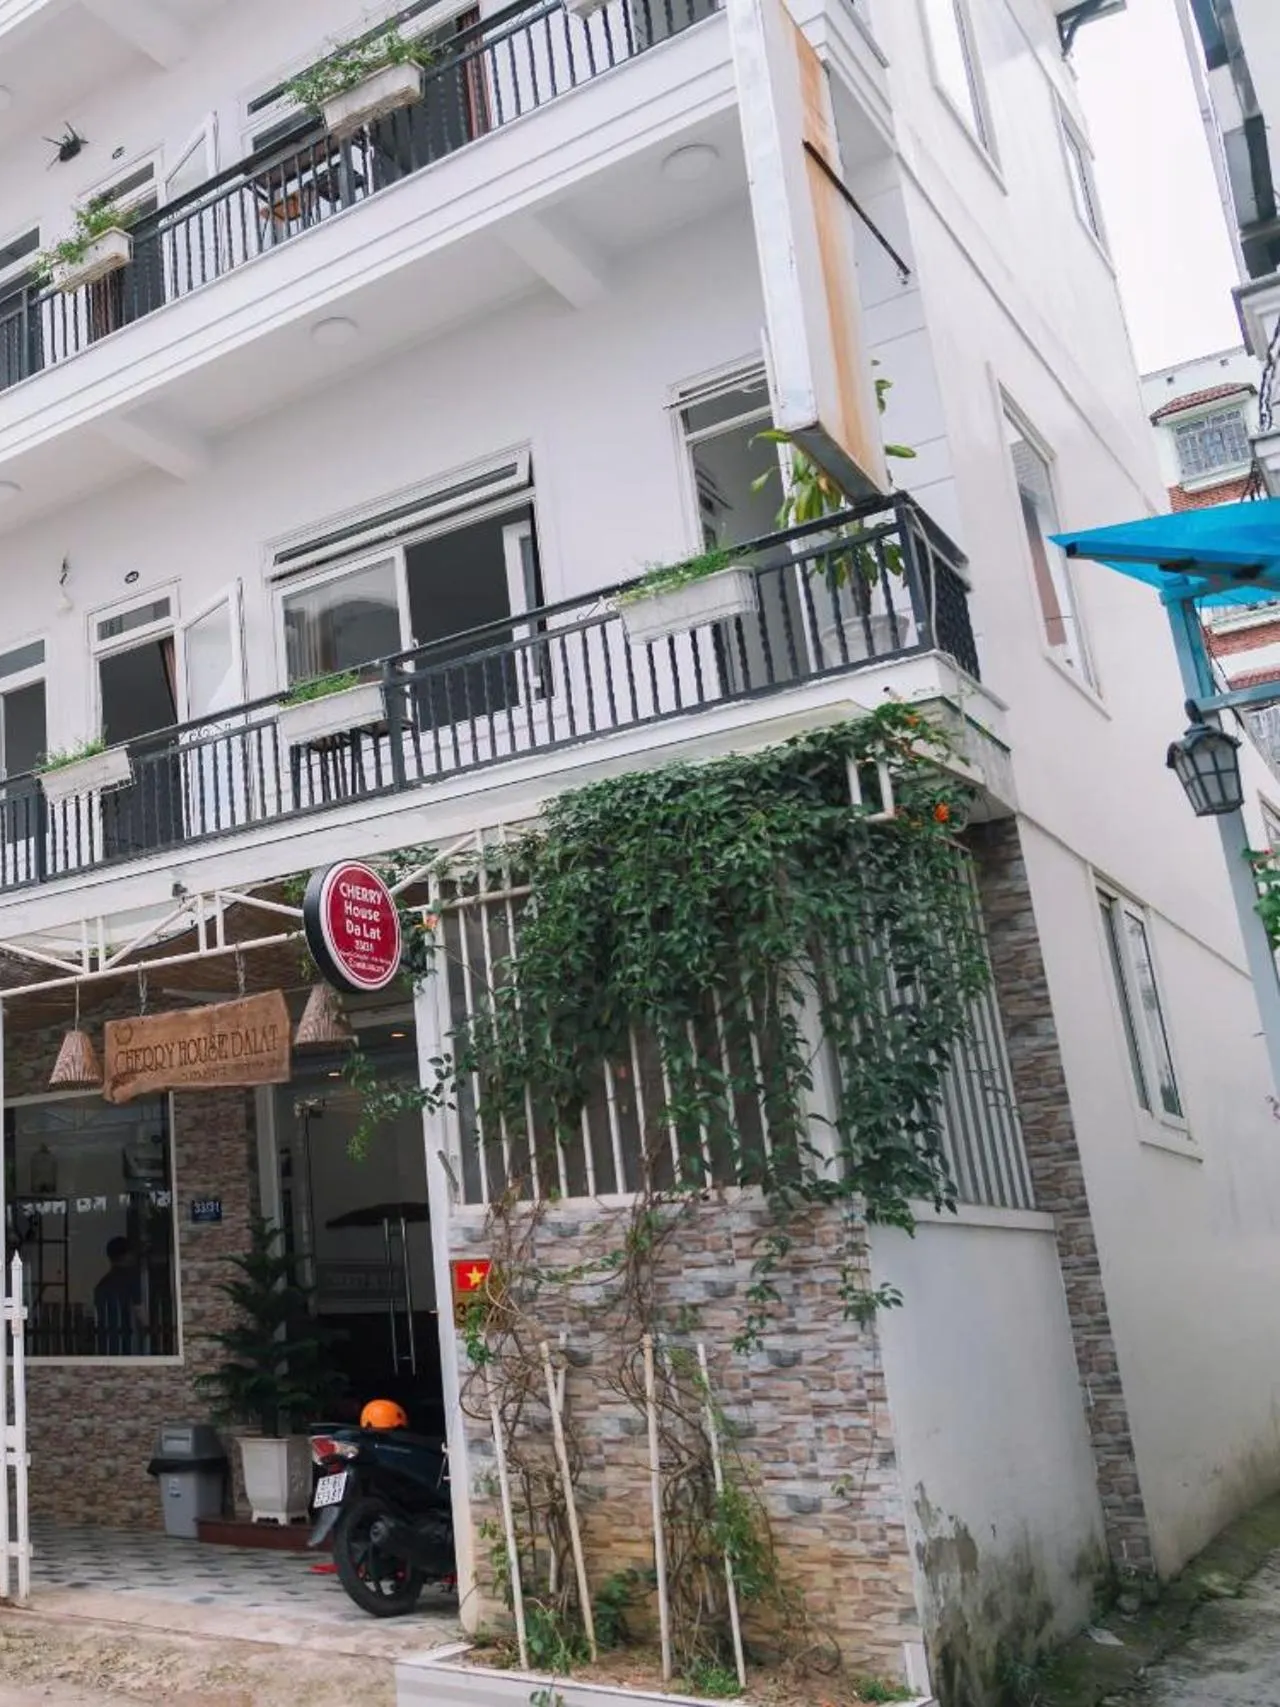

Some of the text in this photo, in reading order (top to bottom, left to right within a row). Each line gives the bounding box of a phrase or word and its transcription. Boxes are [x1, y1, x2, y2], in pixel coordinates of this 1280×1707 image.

[339, 882, 383, 905] CHERRY
[344, 901, 381, 922] House
[345, 919, 382, 941] Da Lat
[178, 1034, 228, 1067] HOUSE
[231, 1024, 278, 1059] DALAT
